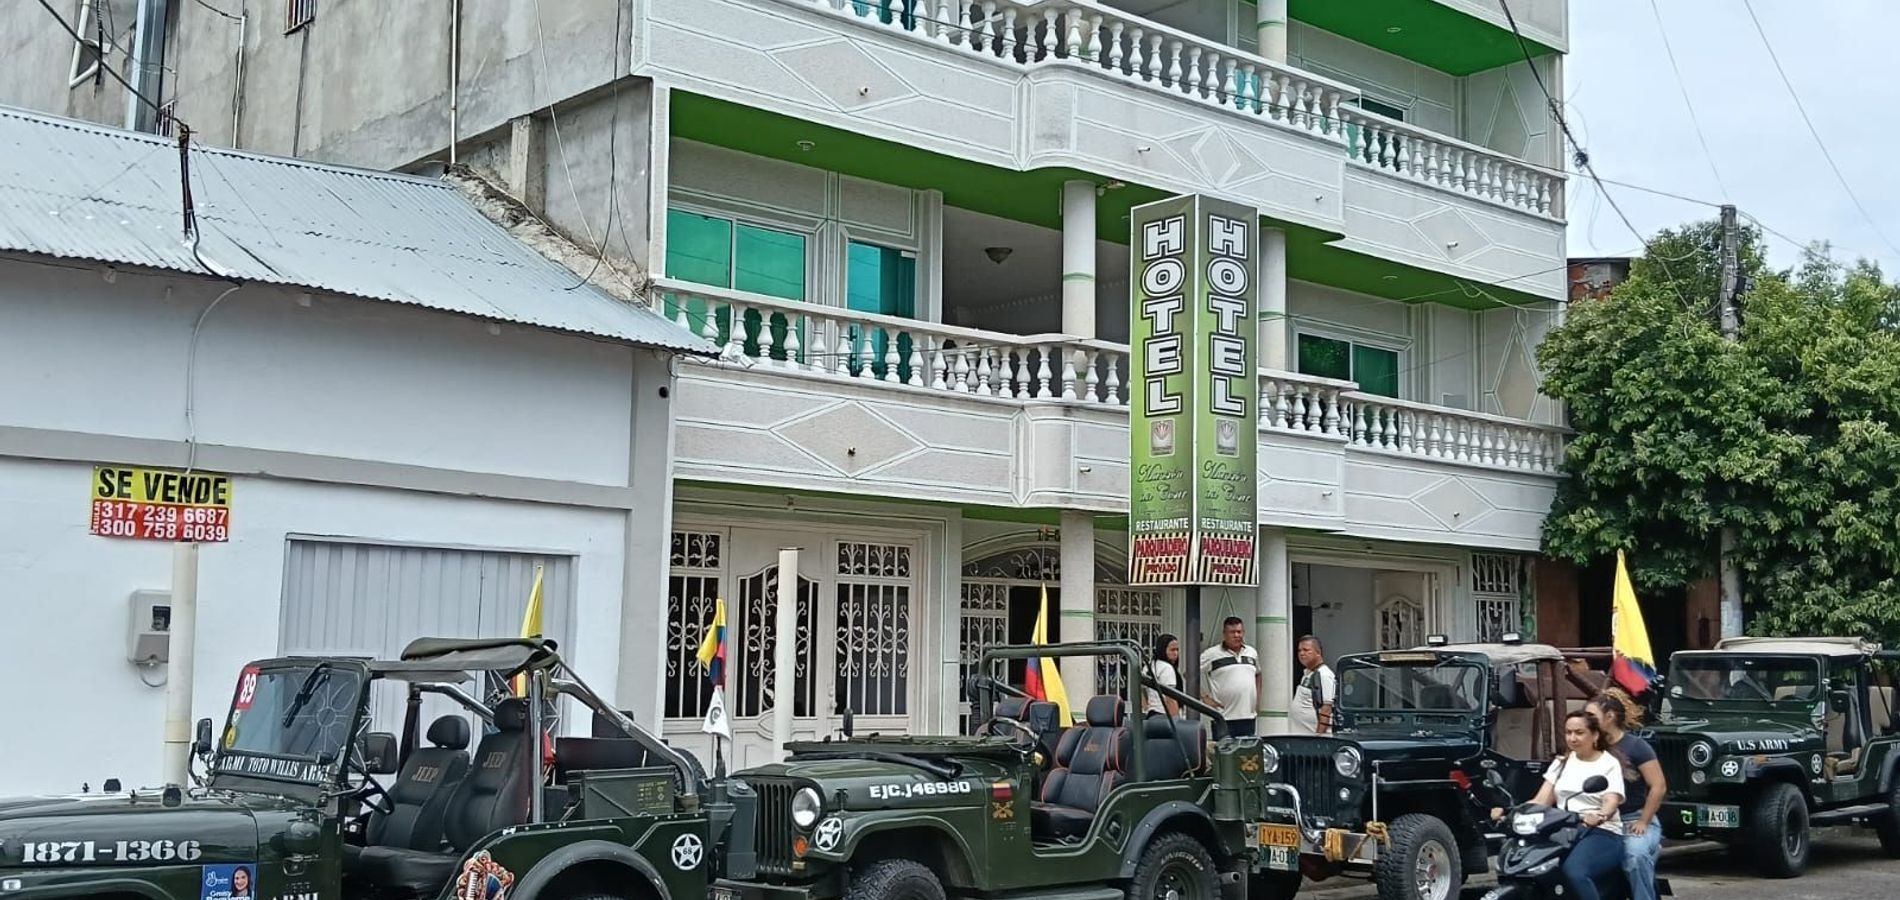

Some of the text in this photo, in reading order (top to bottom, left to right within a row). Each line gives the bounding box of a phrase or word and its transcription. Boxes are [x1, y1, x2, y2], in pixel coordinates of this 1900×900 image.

[1141, 215, 1186, 417] HOTEL
[1206, 214, 1249, 417] HOTEL
[98, 468, 227, 505] SE VENDE
[102, 502, 227, 524] 317 239 6687
[100, 519, 226, 541] 300 758 6039
[1136, 518, 1189, 531] RESTAURANTE
[1201, 518, 1252, 531] RESTAURANTE
[1135, 538, 1188, 559] PARQUEADERO
[1201, 538, 1252, 559] PARQUEADERO
[1144, 563, 1177, 574] PRIVADO
[1211, 563, 1243, 575] PRIVADO
[240, 673, 257, 703] 89
[1736, 740, 1756, 751] U.S
[1759, 739, 1790, 750] ARMY
[411, 766, 439, 783] JEEP
[22, 839, 202, 863] 1871-1366
